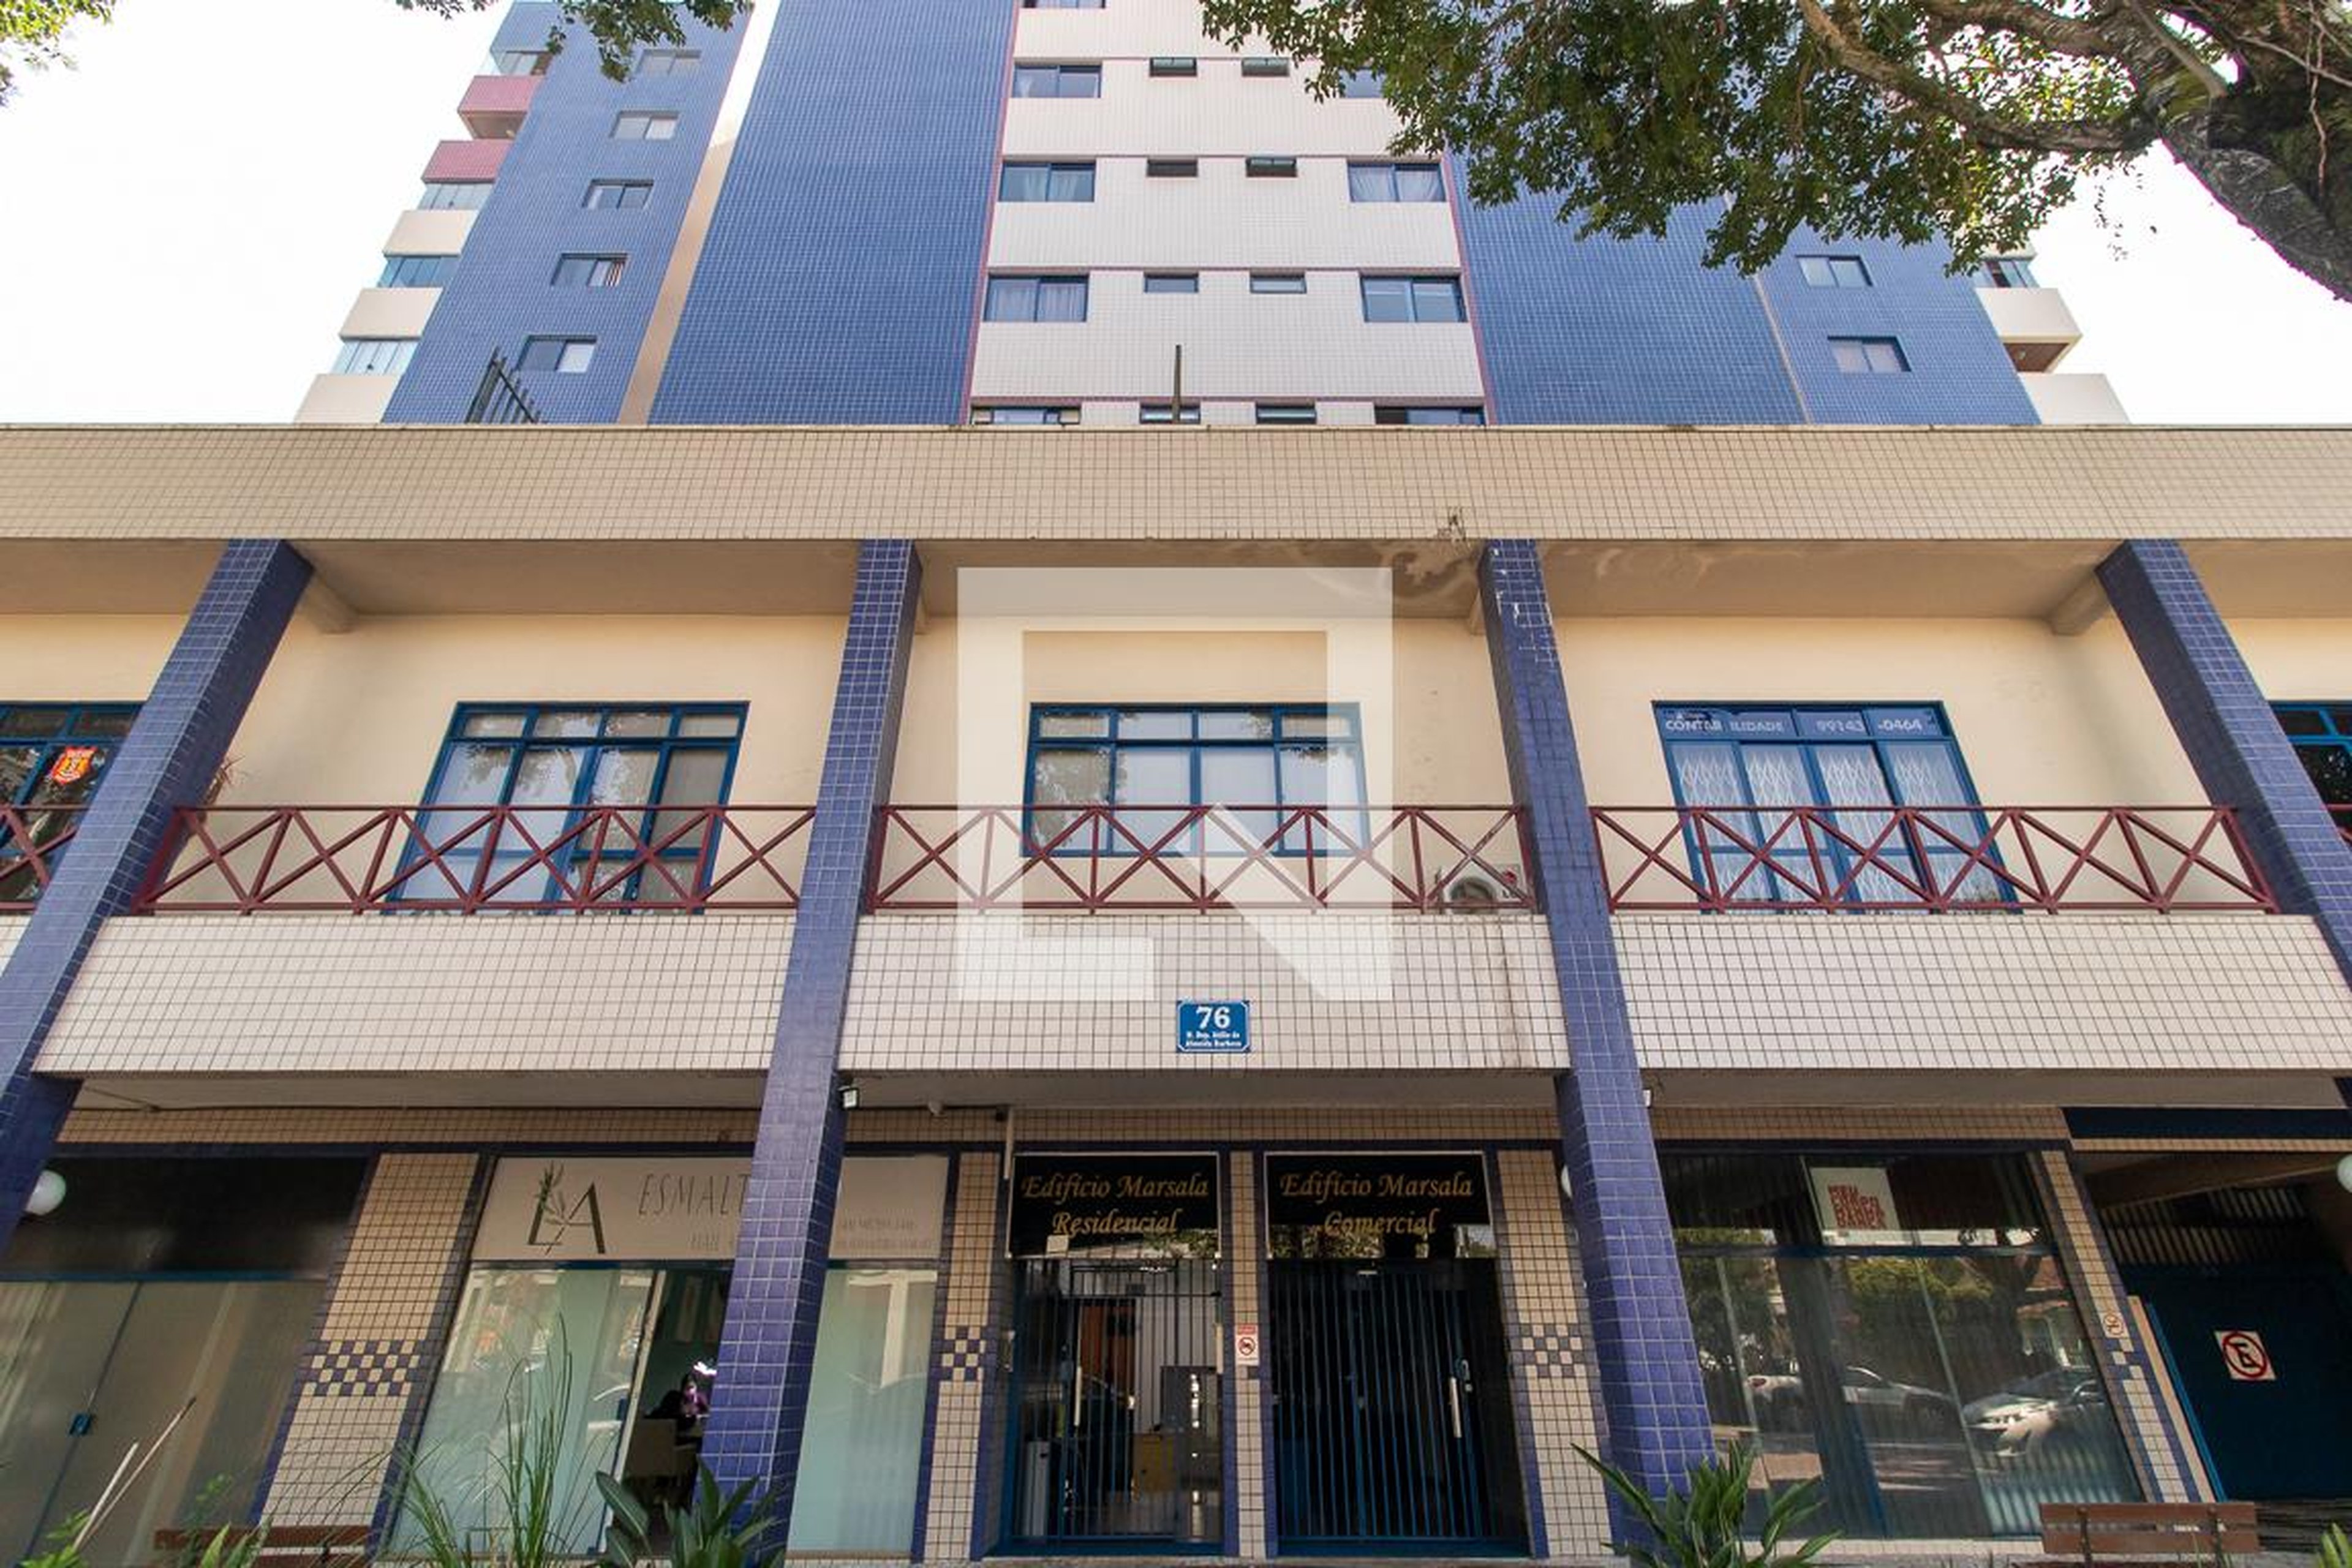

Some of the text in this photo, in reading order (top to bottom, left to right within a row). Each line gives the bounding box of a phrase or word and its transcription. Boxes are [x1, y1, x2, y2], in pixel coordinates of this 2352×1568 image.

[1196, 1006, 1231, 1030] 76
[1115, 1172, 1209, 1198] Marsala
[1378, 1170, 1472, 1196] Marsala
[1052, 1208, 1183, 1238] Residencial
[1324, 1208, 1441, 1238] Comercial
